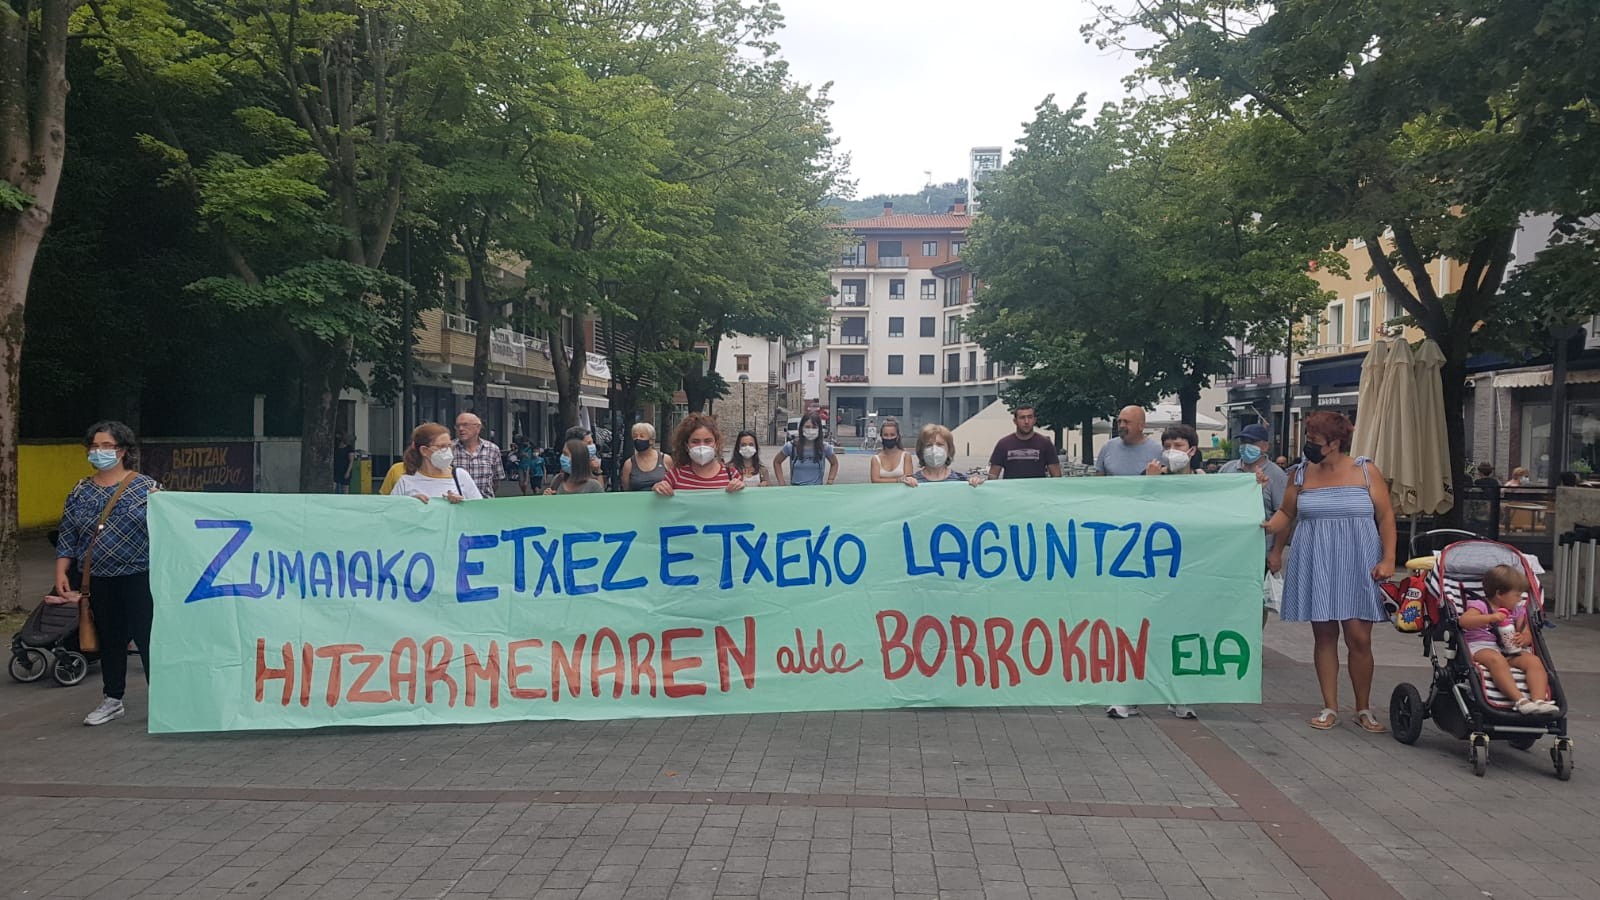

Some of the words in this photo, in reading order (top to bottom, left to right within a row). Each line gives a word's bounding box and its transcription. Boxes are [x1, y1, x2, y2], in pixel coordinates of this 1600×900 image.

[172, 446, 230, 470] BIZITZAK
[185, 519, 436, 604] ZUMAIAKO
[455, 526, 647, 603] ETXEZ
[659, 523, 867, 590] ETXEKO
[902, 518, 1183, 582] LAGUNTZA
[254, 616, 756, 708] HITZARMENAREN
[776, 630, 864, 675] alde
[876, 609, 1150, 690] BORROKAN
[1171, 629, 1251, 681] ELA
